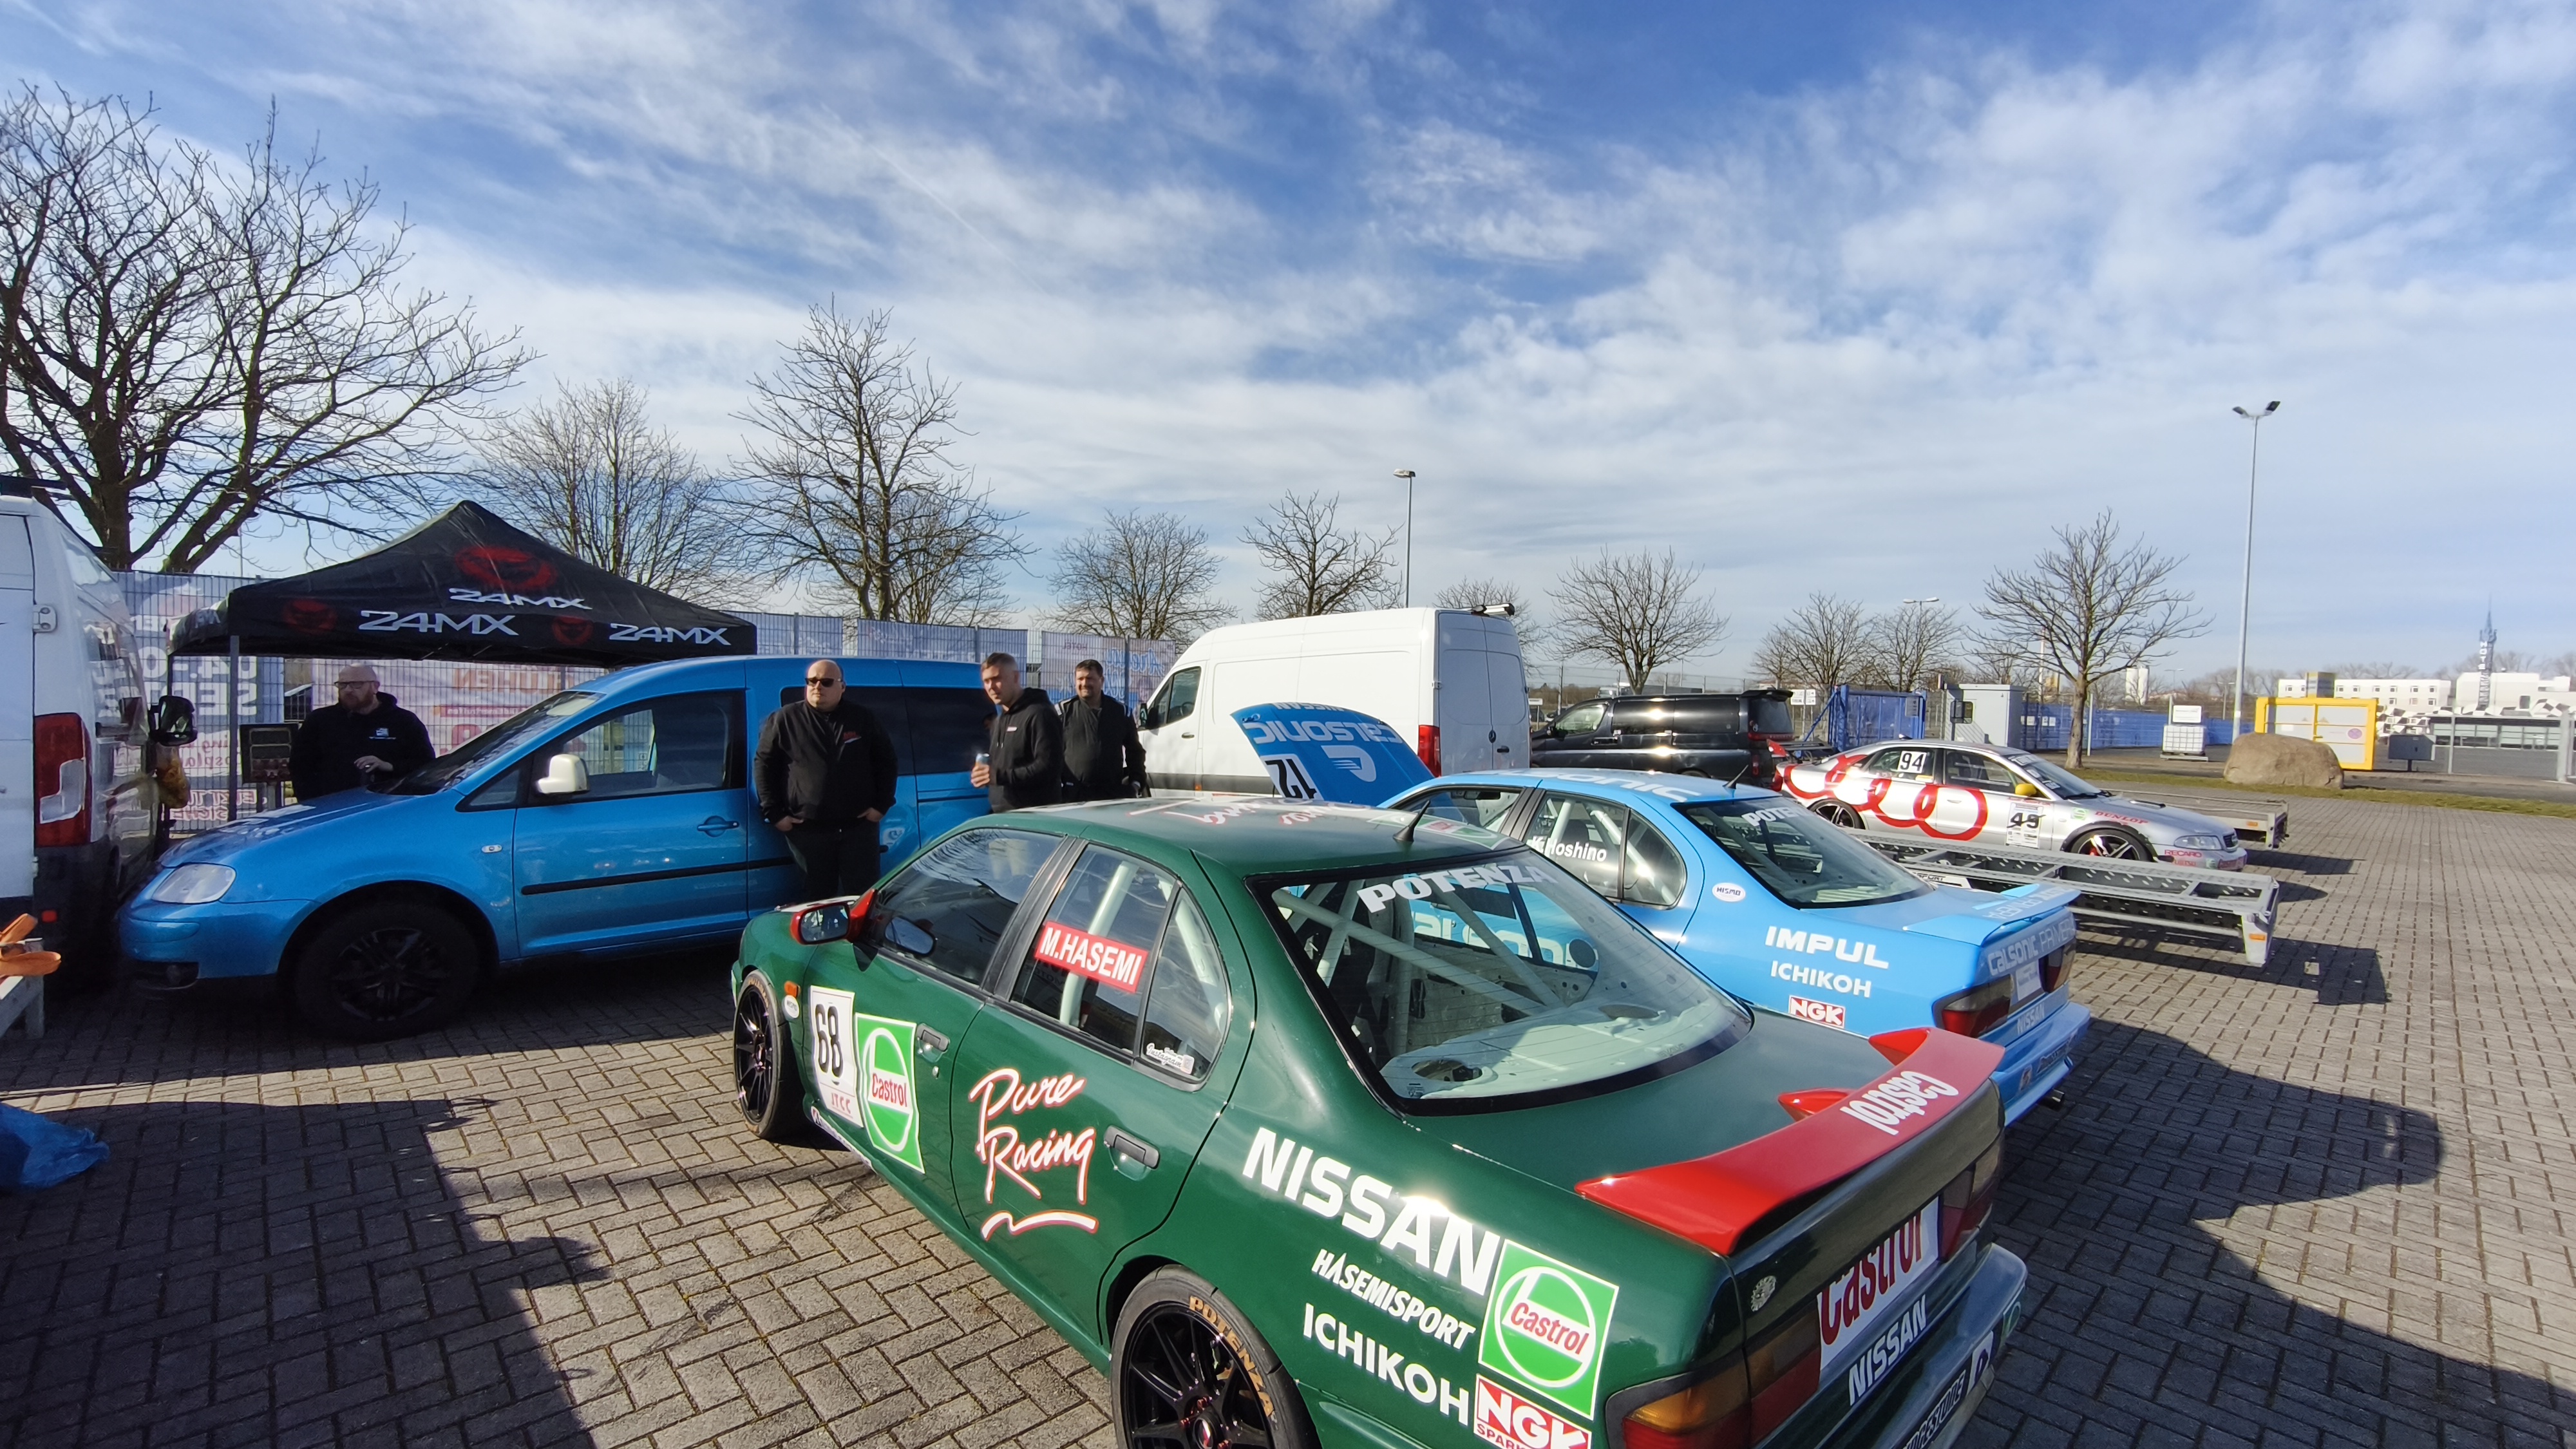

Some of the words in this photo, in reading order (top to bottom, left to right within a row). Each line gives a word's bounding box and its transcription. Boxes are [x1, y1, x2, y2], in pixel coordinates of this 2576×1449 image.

[358, 610, 519, 636] 24MX
[609, 623, 731, 646] 24MX
[1265, 758, 1318, 800] 12
[1900, 752, 1923, 772] 94
[2094, 810, 2149, 825] DUNLOP
[2164, 849, 2202, 858] RECARO
[1356, 862, 1558, 913] POTENZA
[1039, 926, 1142, 985] M.HASEMI
[1765, 925, 1889, 970] IMPUL
[1770, 960, 1872, 998] ICHIKOH
[815, 1003, 844, 1078] 68
[1789, 998, 1843, 1026] NGK
[871, 1073, 907, 1108] Castrol
[969, 1066, 1086, 1165] Pure
[1839, 1070, 1960, 1136] Castrol
[982, 1126, 1096, 1205] Racing
[1242, 1127, 1502, 1297] NISSAN
[1311, 1248, 1476, 1351] HASEMISPORT
[1189, 1294, 1275, 1417] POTENZA
[1508, 1300, 1590, 1358] Castrol
[1848, 1293, 1927, 1406] NISSAN
[1302, 1302, 1470, 1427] ICHIKOH
[1477, 1380, 1587, 1449] NGK
